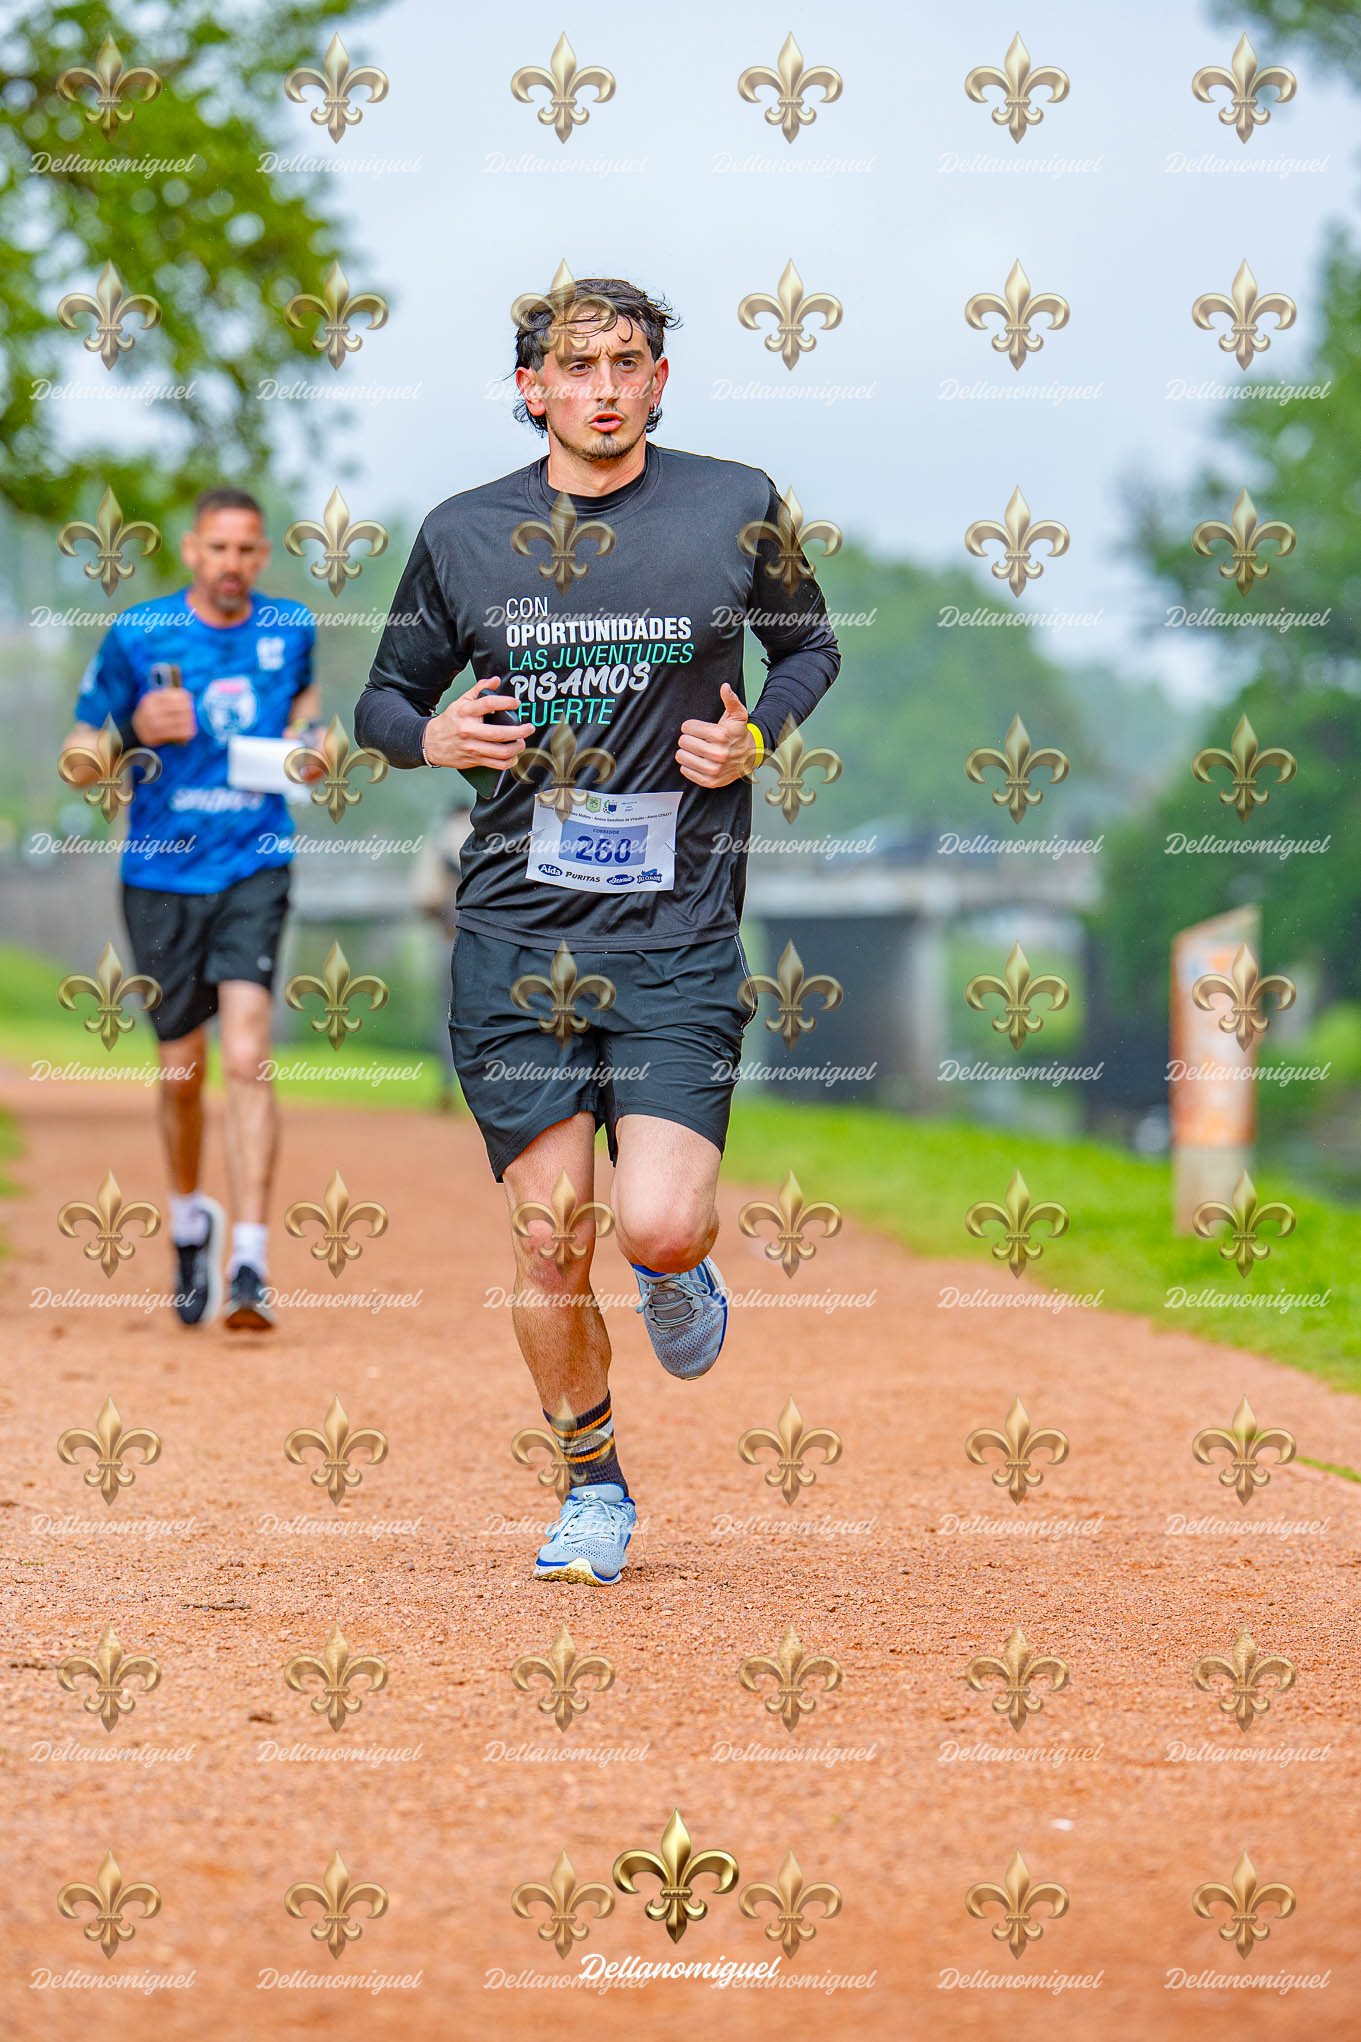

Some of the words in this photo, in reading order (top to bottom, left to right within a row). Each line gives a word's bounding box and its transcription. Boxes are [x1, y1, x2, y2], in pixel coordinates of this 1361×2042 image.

[506, 597, 548, 619] CON
[506, 616, 692, 648] OPORTUNIDADES
[509, 648, 548, 671] LAS
[553, 643, 695, 669] JUVENTUDES
[510, 662, 651, 702] PISAMOS
[518, 698, 616, 727] FUERTE
[576, 835, 632, 864] 260
[565, 871, 601, 883] PURITAS
